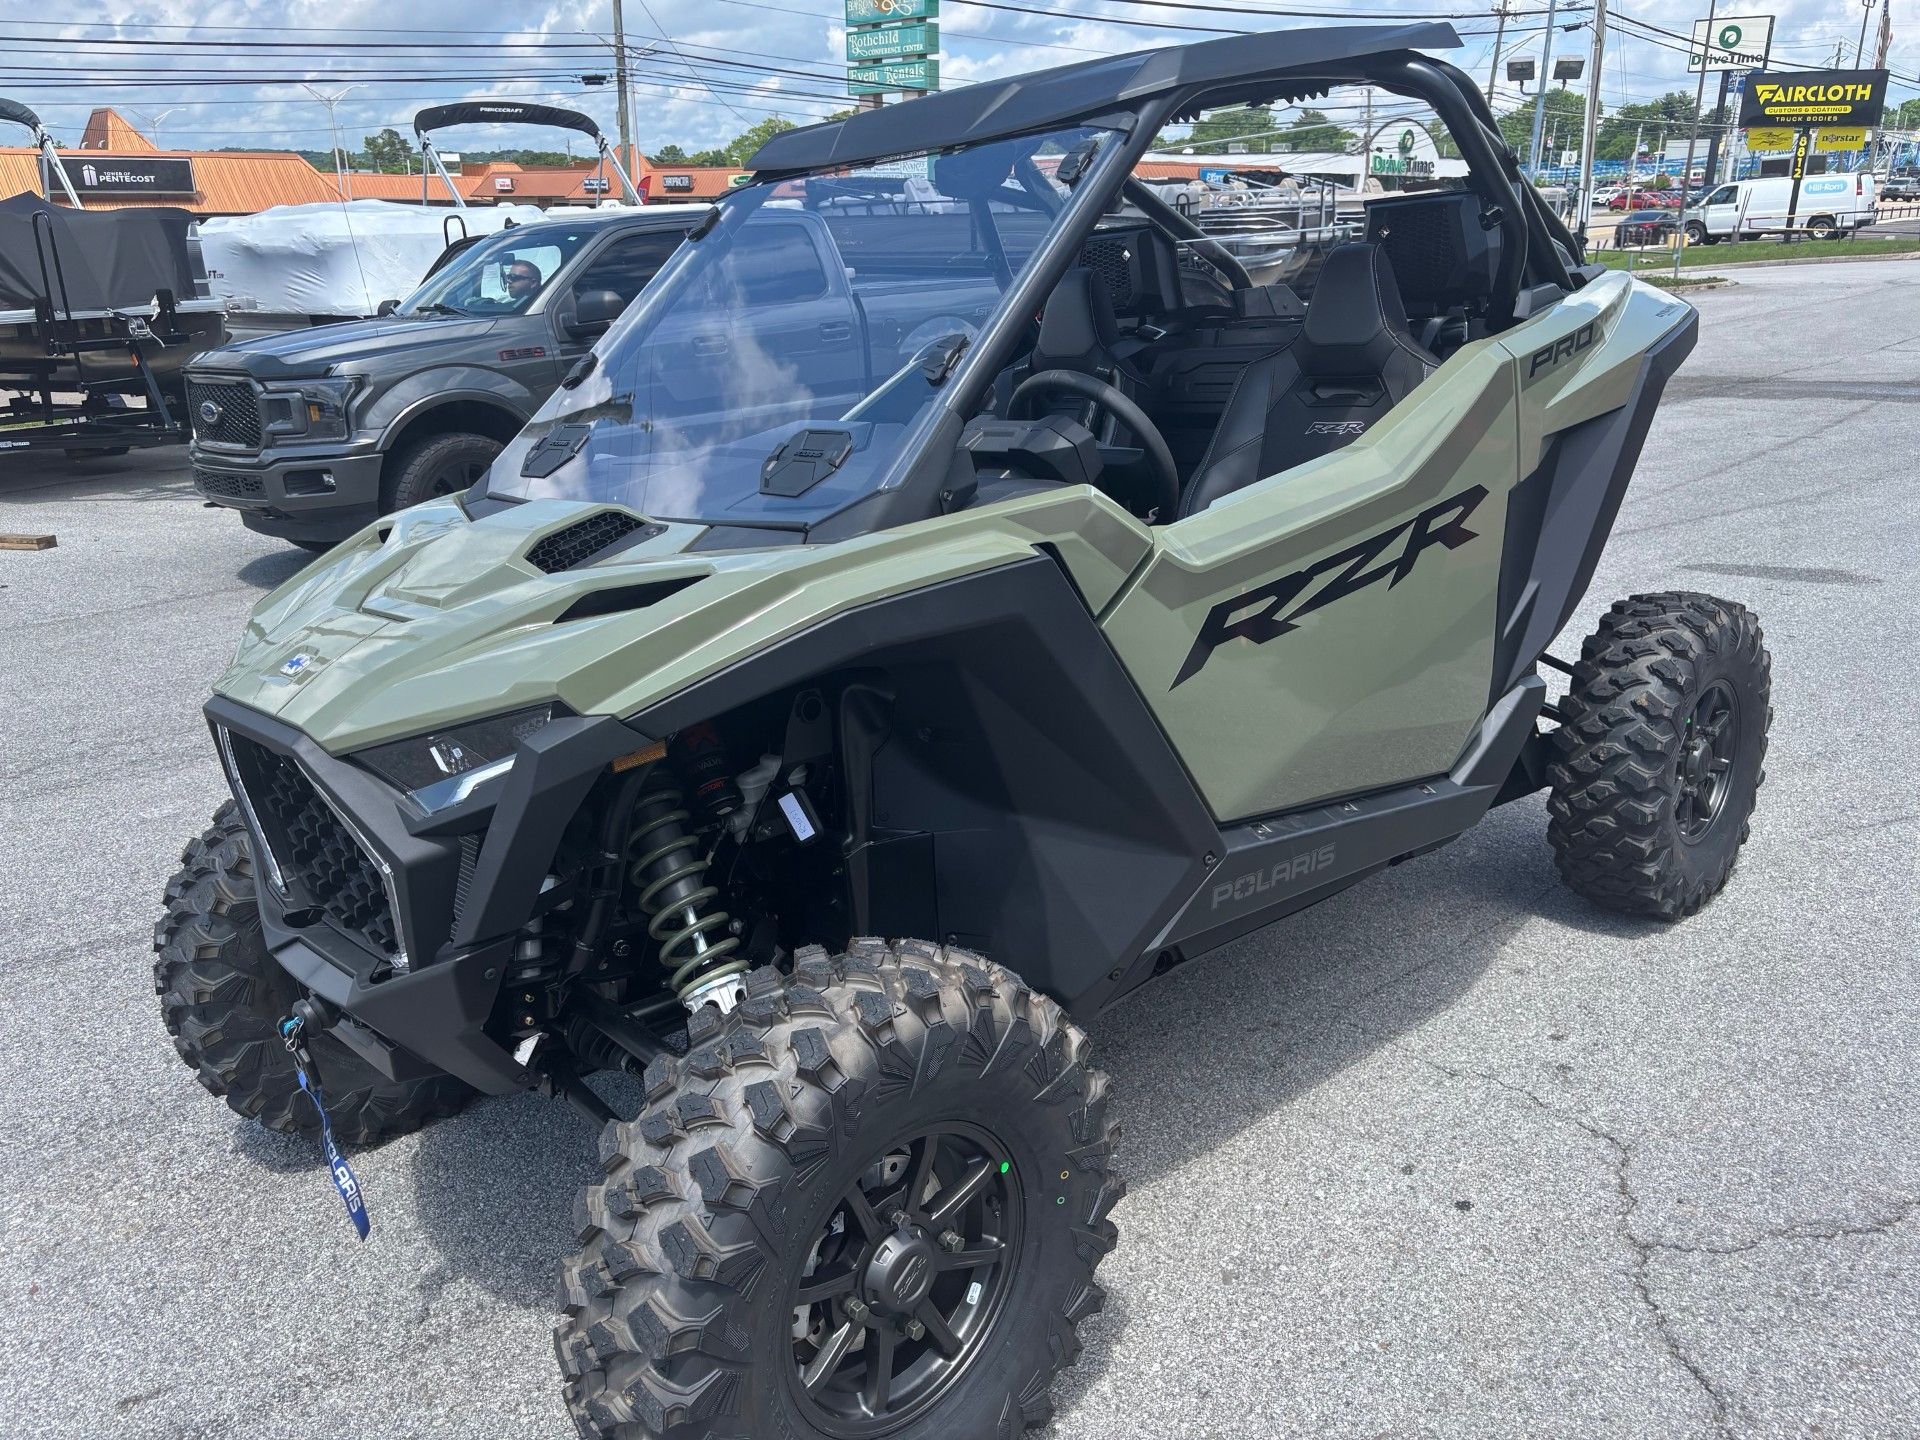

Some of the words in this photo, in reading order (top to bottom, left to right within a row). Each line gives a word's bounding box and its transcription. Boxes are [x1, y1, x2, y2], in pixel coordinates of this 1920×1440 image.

[848, 30, 899, 49] Rothchild
[903, 43, 924, 52] CENTER
[848, 69, 879, 81] Event
[884, 63, 925, 80] Rentals
[1755, 84, 1872, 106] FAIRCLOTH
[1372, 153, 1435, 174] DriveTime
[99, 175, 156, 183] PENTECOST
[1529, 321, 1594, 379] PRO
[1304, 421, 1365, 435] RZR
[1167, 483, 1490, 693] RZR
[1211, 841, 1336, 910] POLARIS
[325, 1127, 362, 1214] POLARIS
